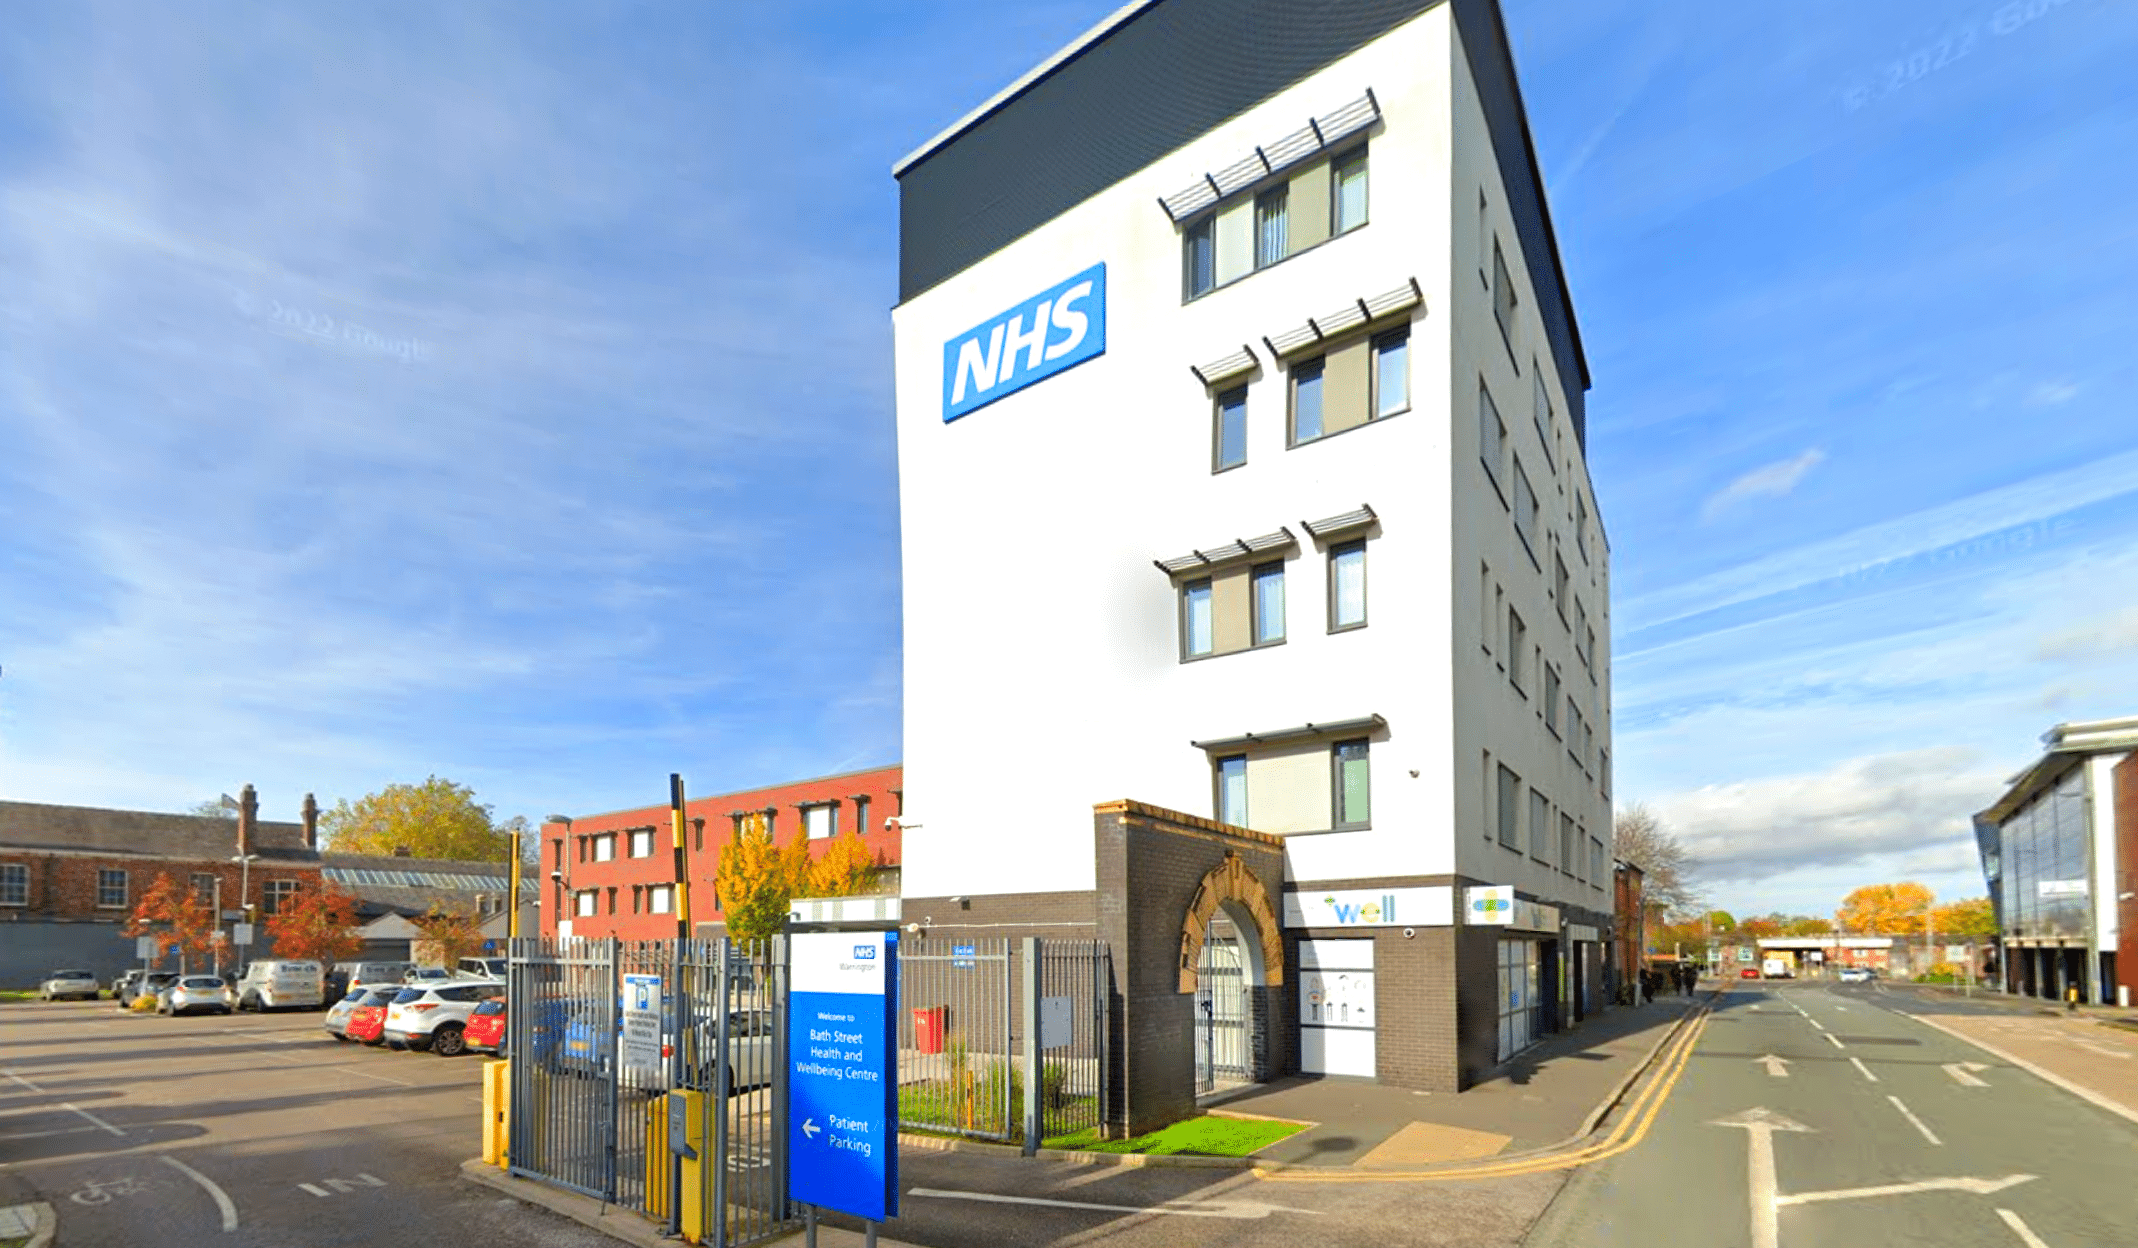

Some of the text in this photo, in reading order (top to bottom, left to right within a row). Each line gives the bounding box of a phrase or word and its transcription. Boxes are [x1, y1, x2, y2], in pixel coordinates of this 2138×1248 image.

[951, 280, 1093, 406] NHS
[1334, 895, 1395, 924] well
[856, 946, 875, 958] NHS
[839, 963, 876, 973] Warrington
[817, 1012, 855, 1022] Welcome to
[810, 1029, 863, 1044] Bath Street
[810, 1046, 863, 1062] Health and
[796, 1062, 879, 1082] Wellbeing Centre
[829, 1114, 869, 1133] Patient
[828, 1135, 872, 1157] Parking
[297, 1173, 388, 1198] IN
